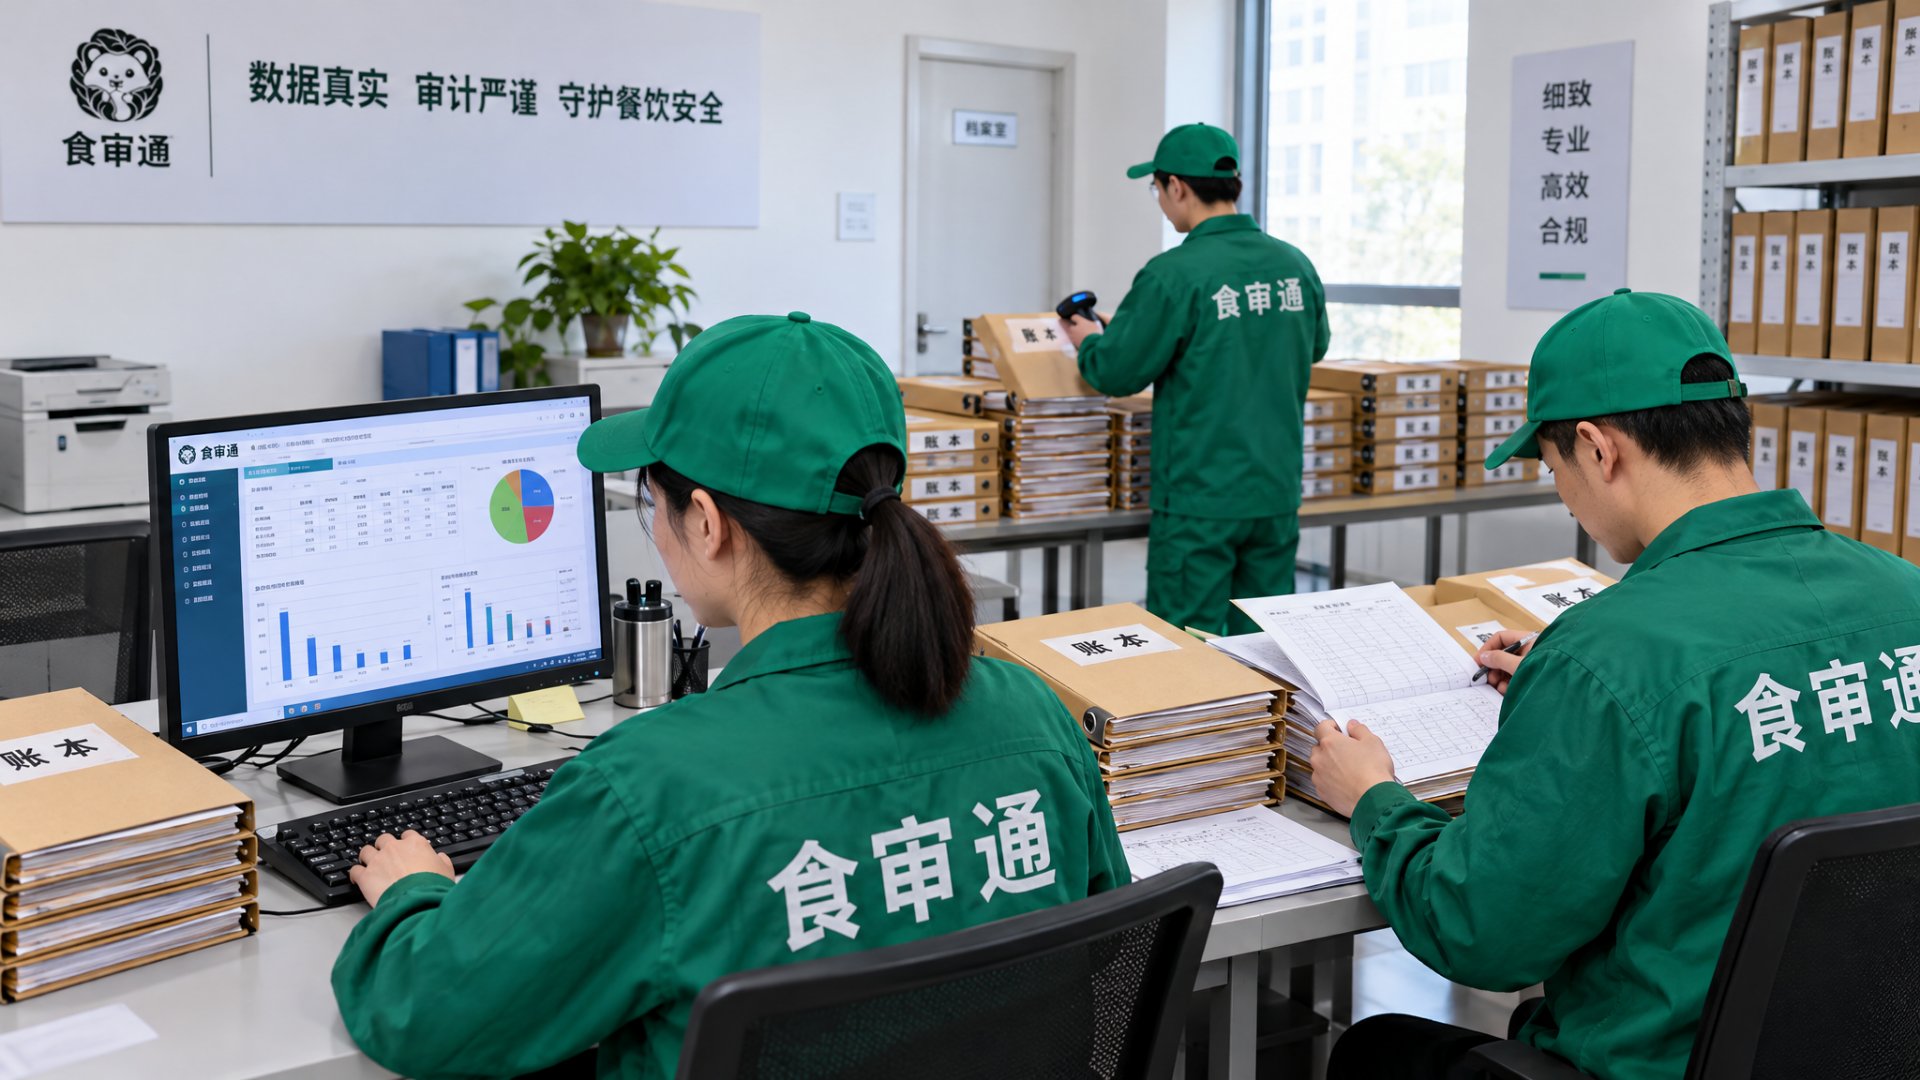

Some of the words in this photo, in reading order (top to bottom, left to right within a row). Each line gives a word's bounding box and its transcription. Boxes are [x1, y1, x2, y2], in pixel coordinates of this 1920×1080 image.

[248, 60, 389, 109] 数据真实
[415, 71, 538, 116] 审计严谨
[558, 82, 723, 125] 守护餐饮安全
[1542, 79, 1592, 110] 细致
[965, 120, 1007, 138] 档案室
[1541, 125, 1591, 155] 专业
[62, 131, 171, 168] 食审通
[1541, 171, 1590, 201] 高效
[1539, 217, 1588, 246] 合规
[1212, 277, 1304, 320] 食审通
[201, 443, 239, 461] 食审通
[1071, 634, 1149, 656] 账本
[0, 738, 99, 771] 账本
[767, 789, 1056, 952] 食审通
